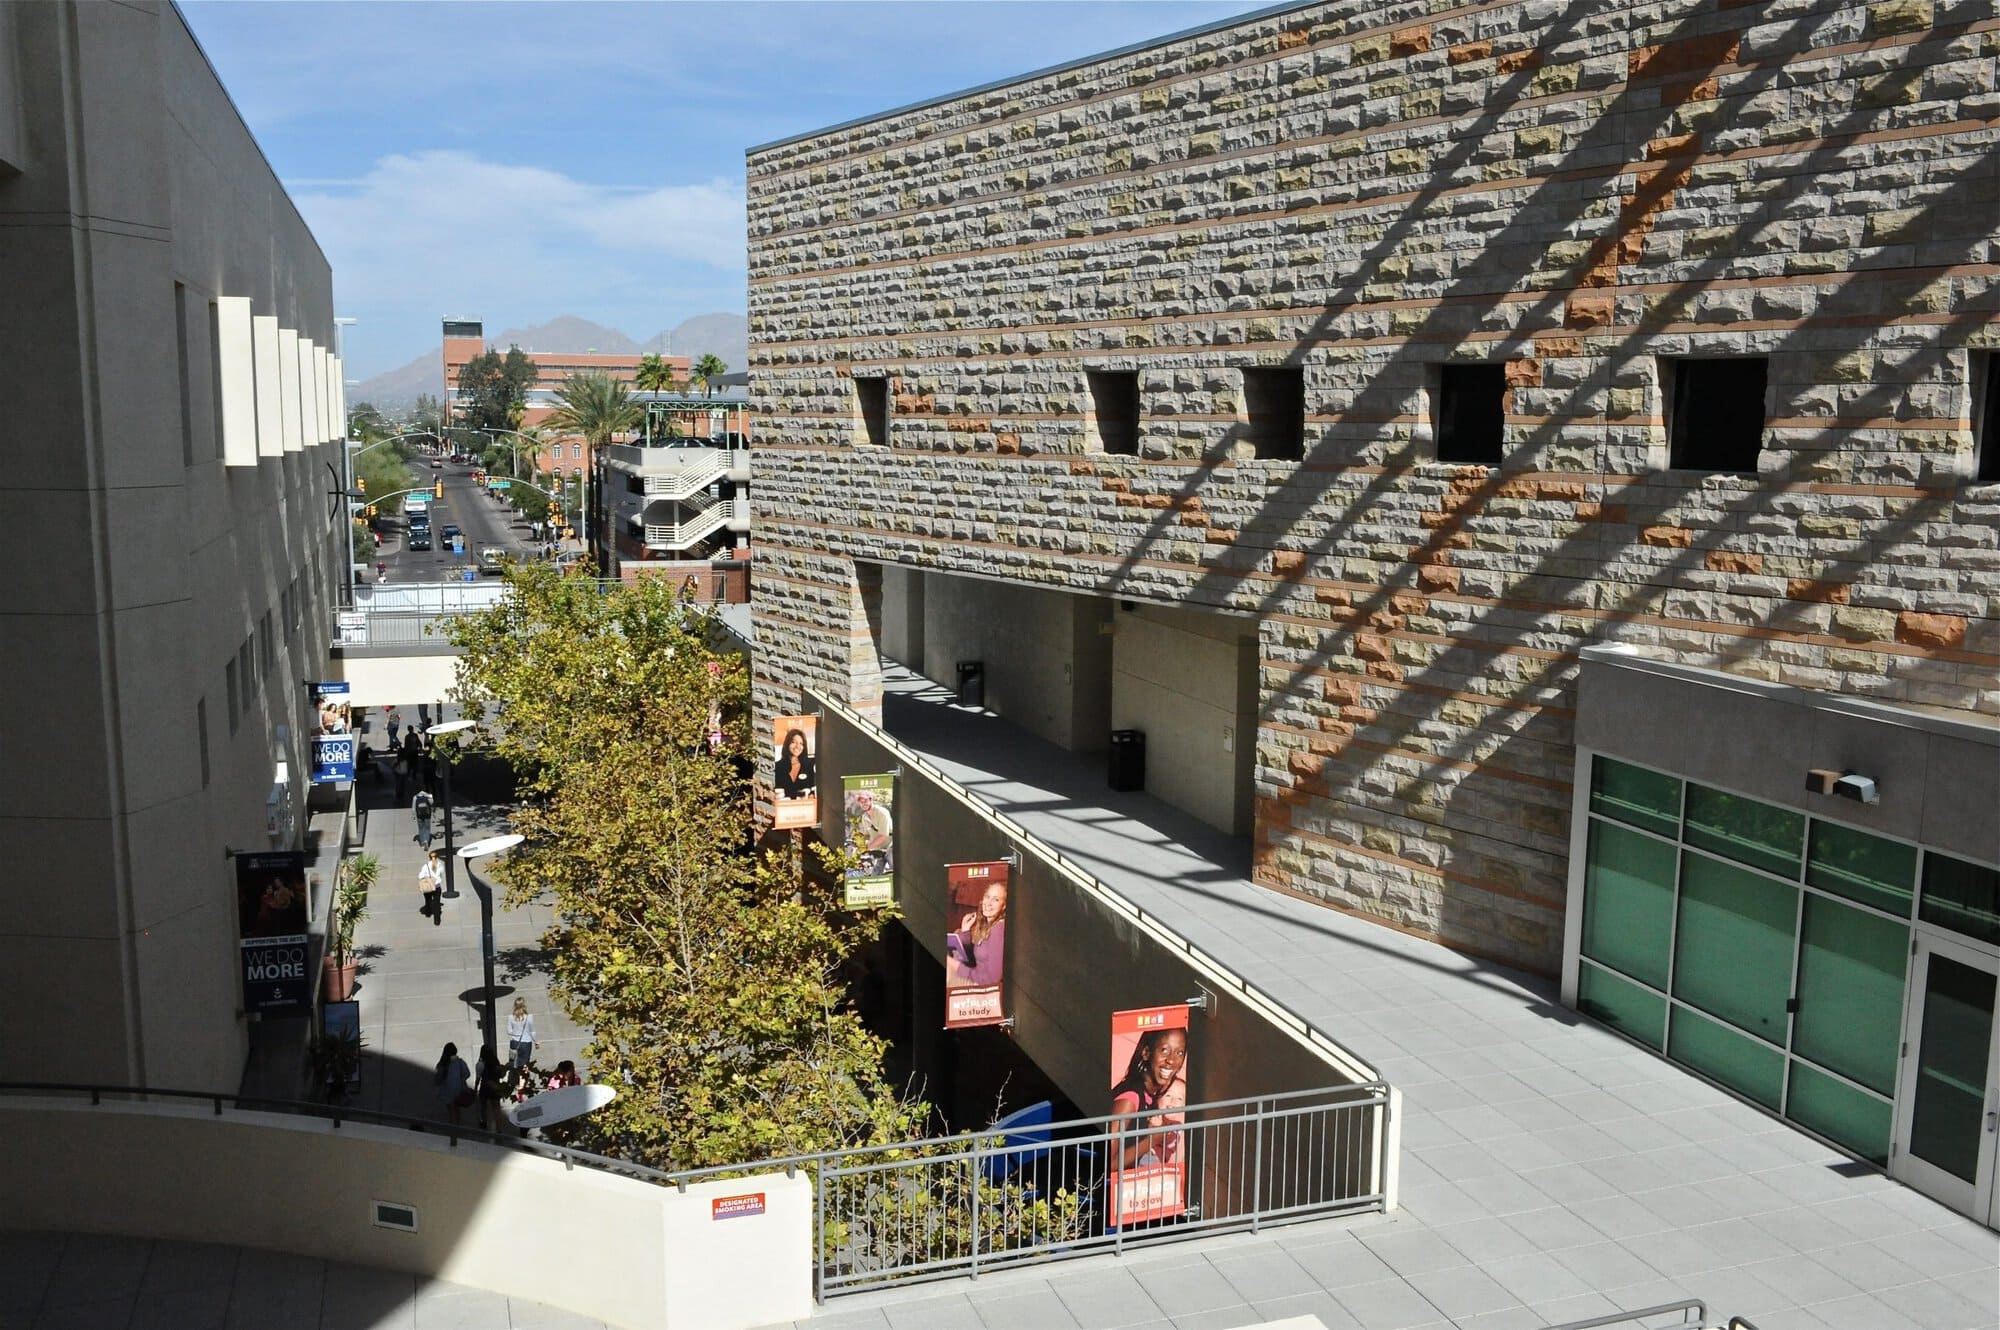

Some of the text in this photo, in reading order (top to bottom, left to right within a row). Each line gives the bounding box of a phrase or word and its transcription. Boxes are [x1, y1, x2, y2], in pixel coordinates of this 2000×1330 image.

[315, 742, 350, 753] WE DO
[315, 752, 350, 762] MORE
[246, 948, 304, 966] WE DO
[247, 963, 305, 980] MORE
[959, 1008, 991, 1017] to study
[720, 1197, 759, 1207] DESIGNATED
[1140, 1197, 1162, 1208] gow
[715, 1202, 763, 1214] SMOKING AREA
